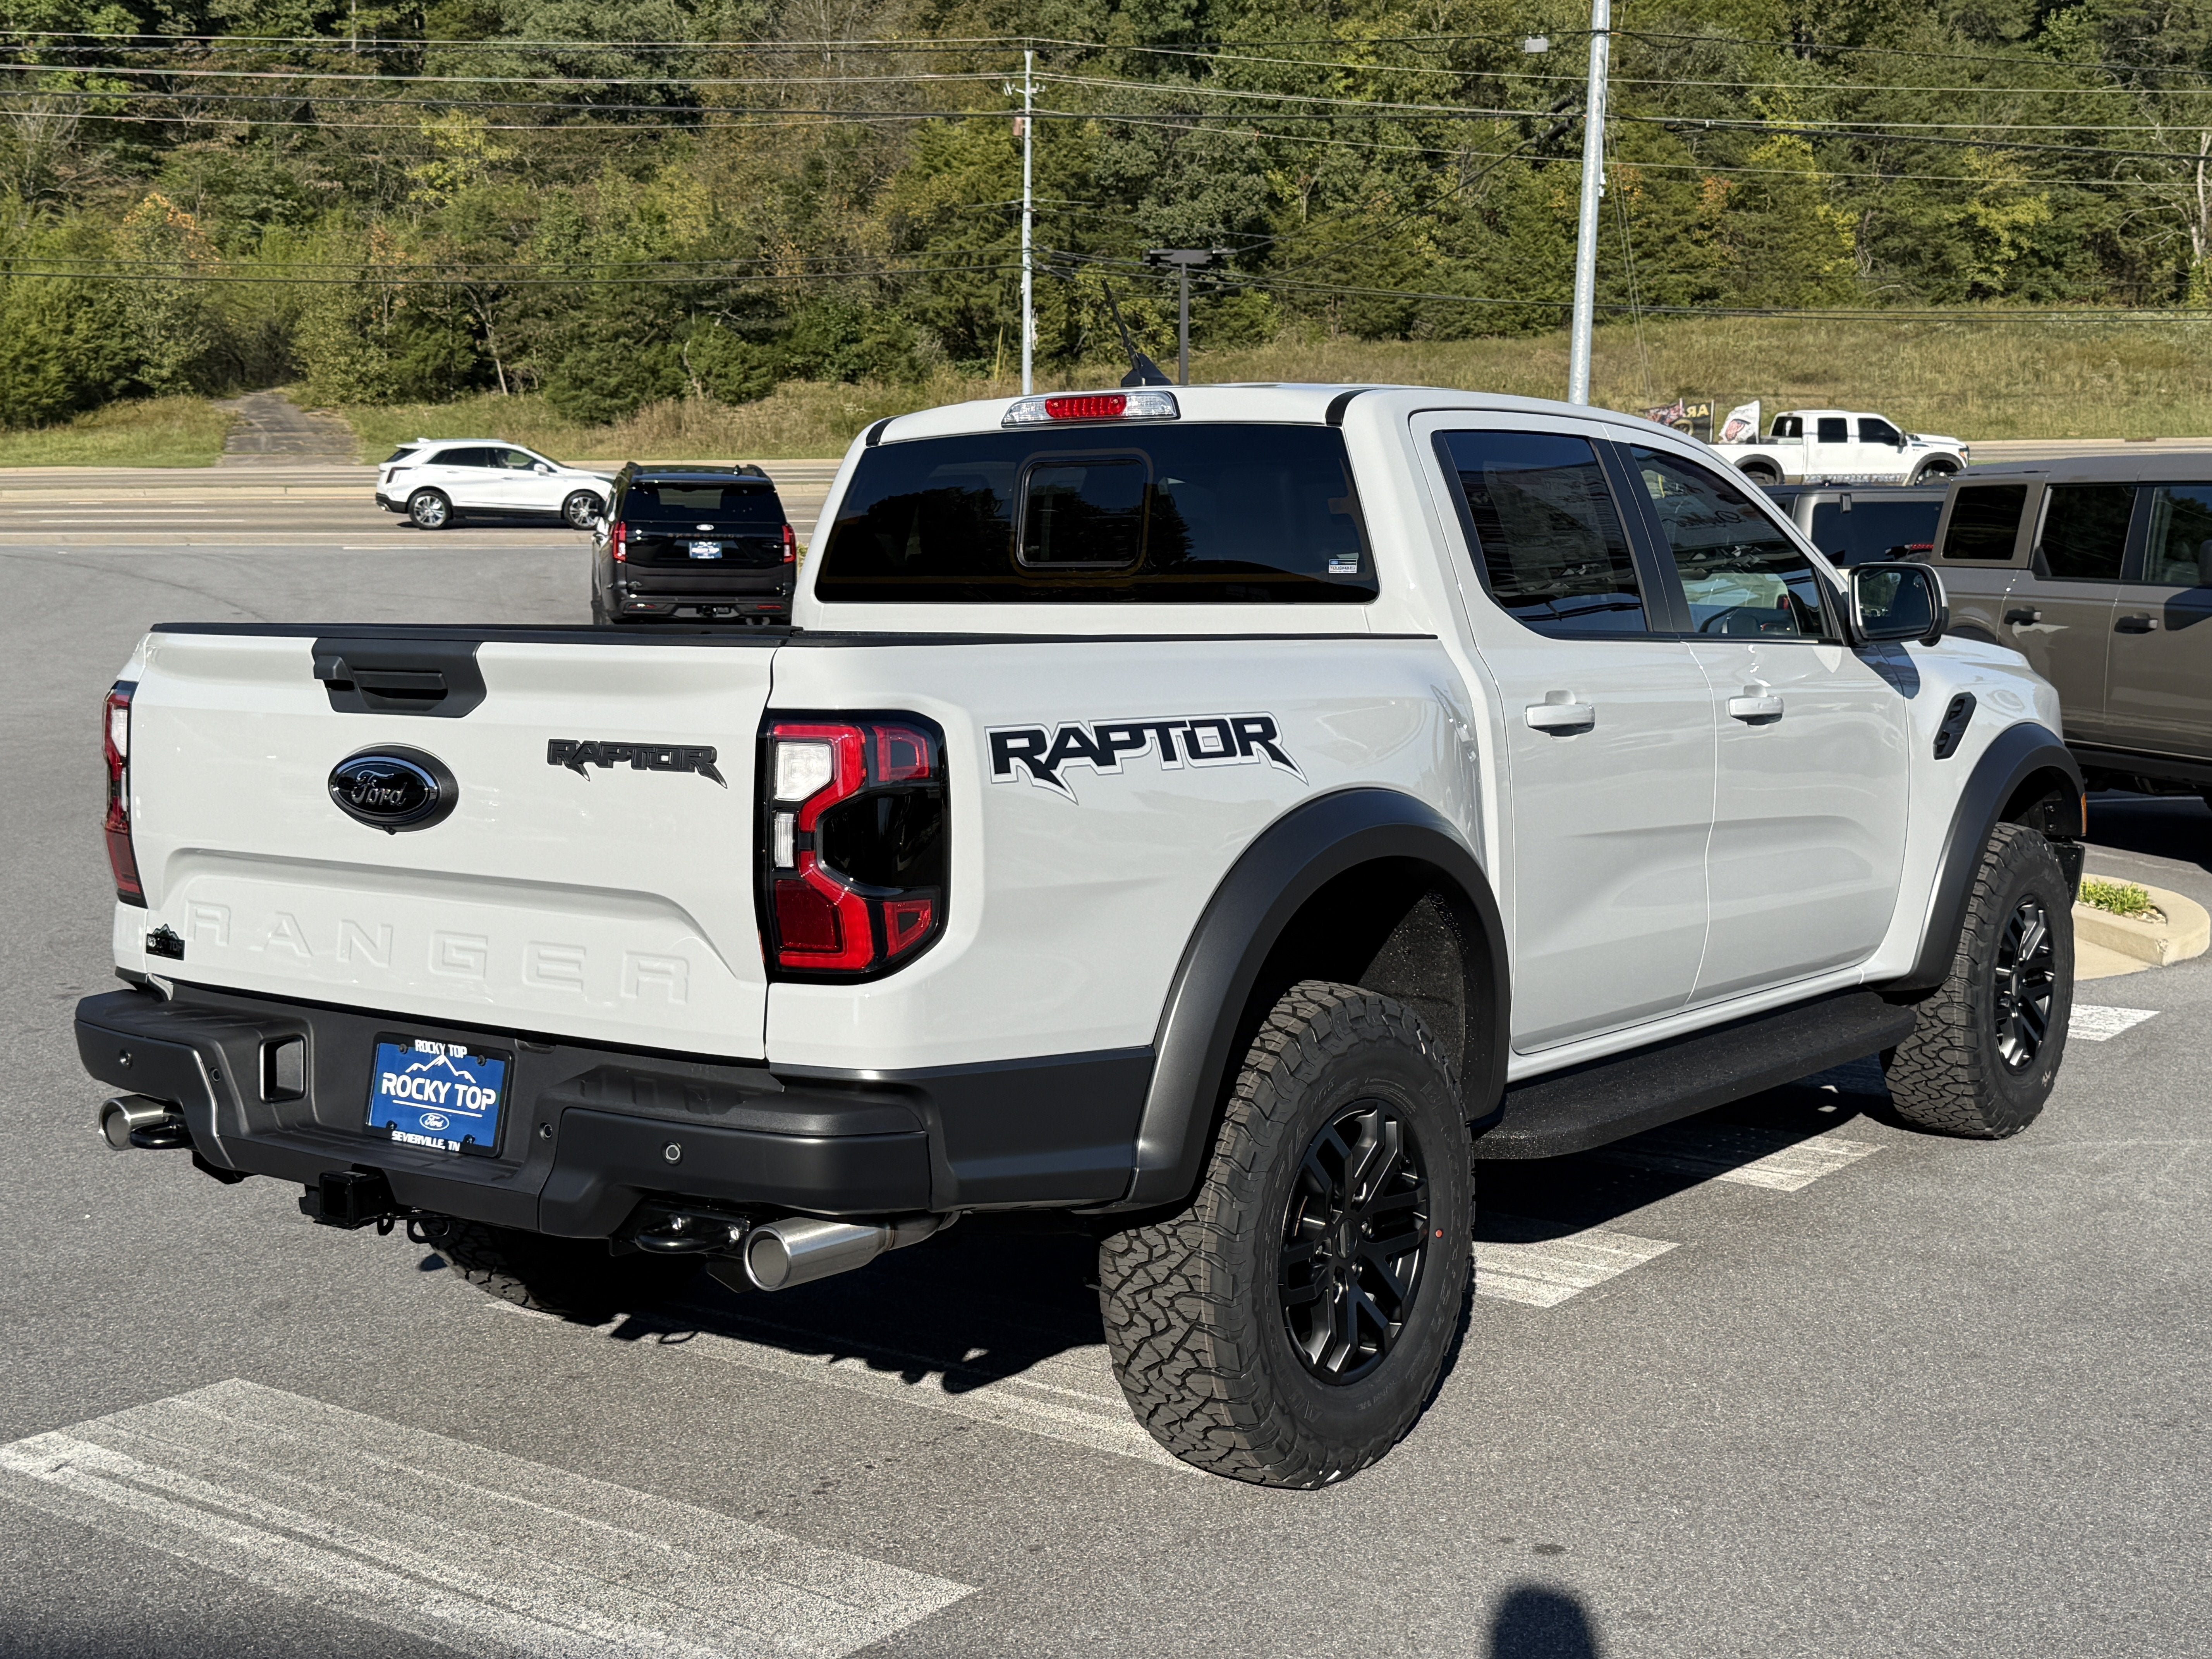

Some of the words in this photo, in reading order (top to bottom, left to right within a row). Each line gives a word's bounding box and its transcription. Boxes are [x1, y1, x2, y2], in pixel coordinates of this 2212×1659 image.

[547, 739, 727, 789] RAPTOR
[985, 711, 1309, 806] RAPTOR
[351, 769, 408, 806] Ford
[185, 900, 690, 1004] RANGER
[415, 1039, 446, 1054] ROCKY
[448, 1044, 467, 1058] TOP
[381, 1072, 452, 1104] ROCKY
[454, 1083, 496, 1110] TOP
[424, 1115, 444, 1128] Ford
[392, 1130, 446, 1150] SEVIERVILLE,
[448, 1140, 460, 1152] TN
